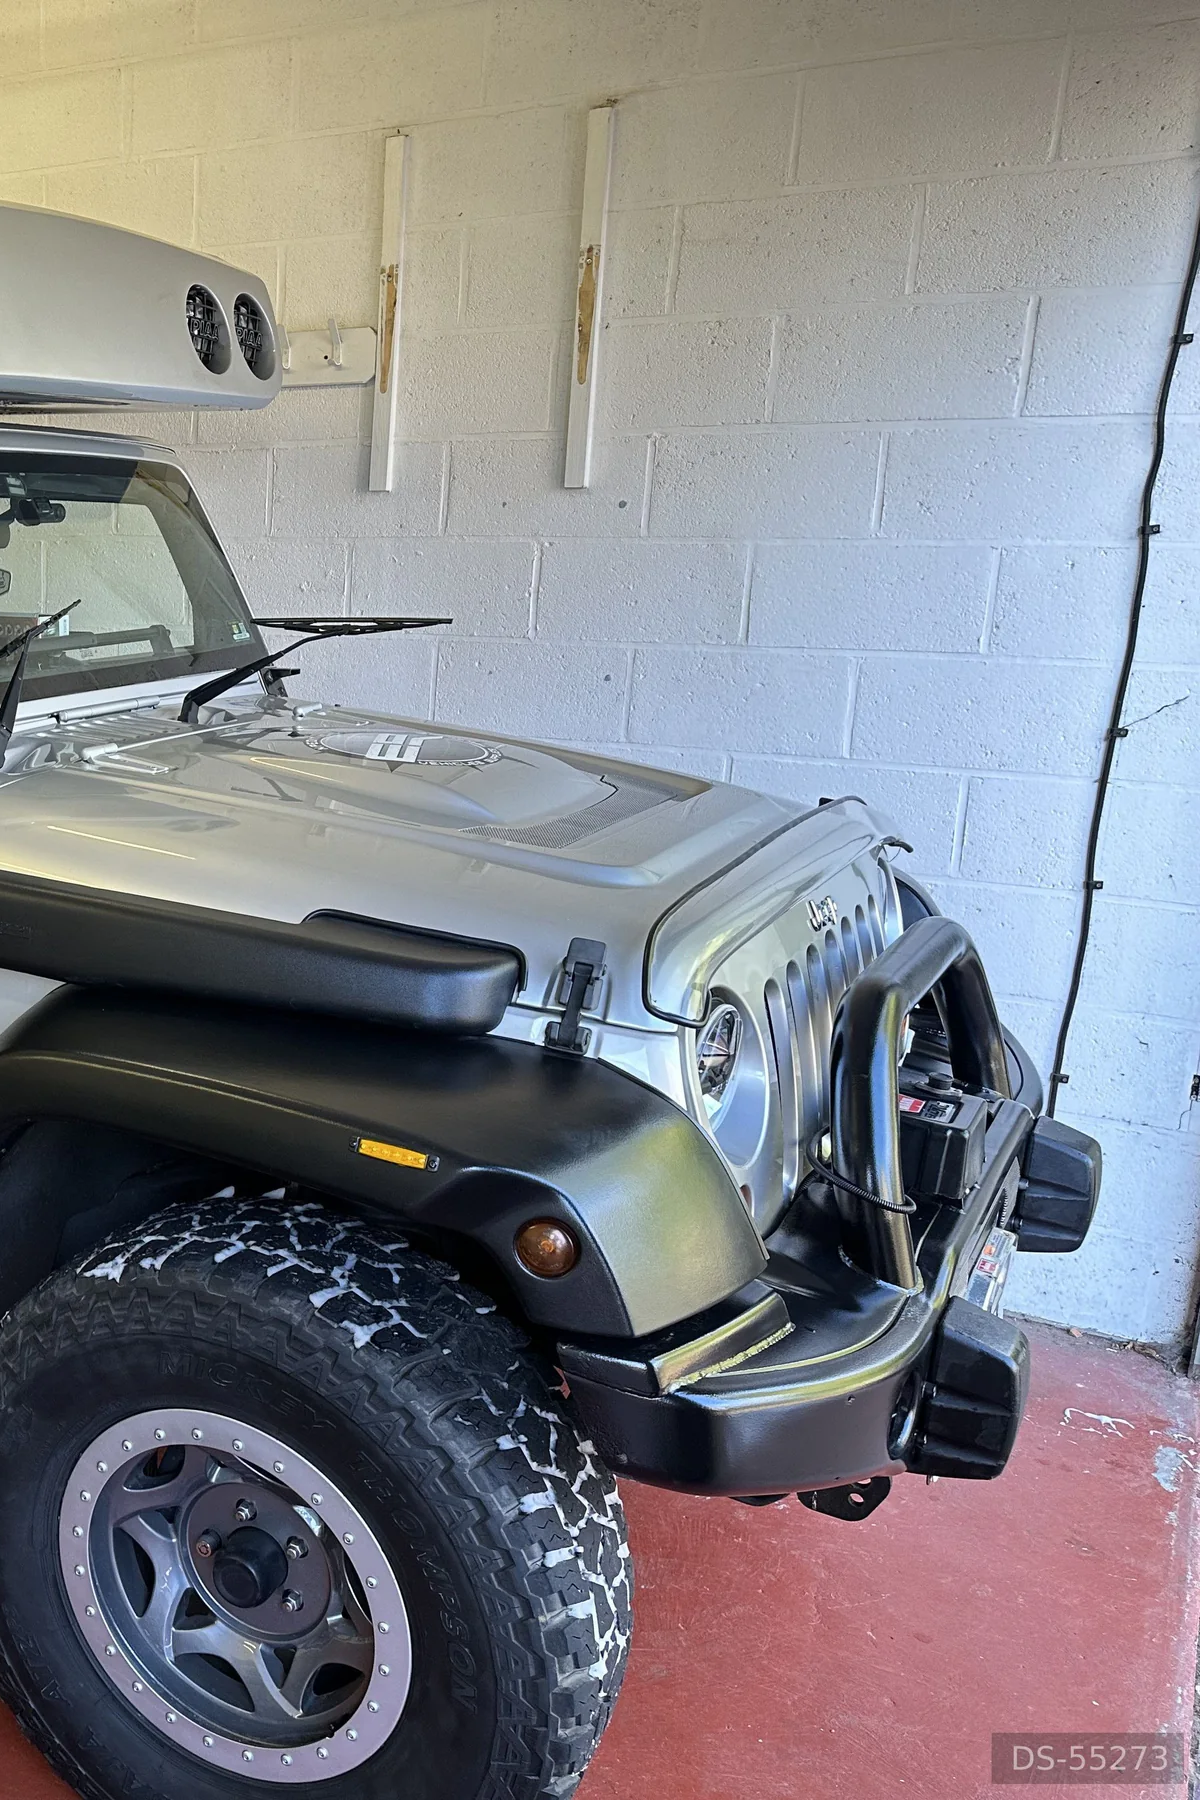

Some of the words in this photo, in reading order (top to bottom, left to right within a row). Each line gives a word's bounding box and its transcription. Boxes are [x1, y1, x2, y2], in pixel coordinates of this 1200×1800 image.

[190, 317, 219, 341] PIAA
[157, 1351, 337, 1431] MICKEY
[350, 1450, 478, 1716] THOMPSON
